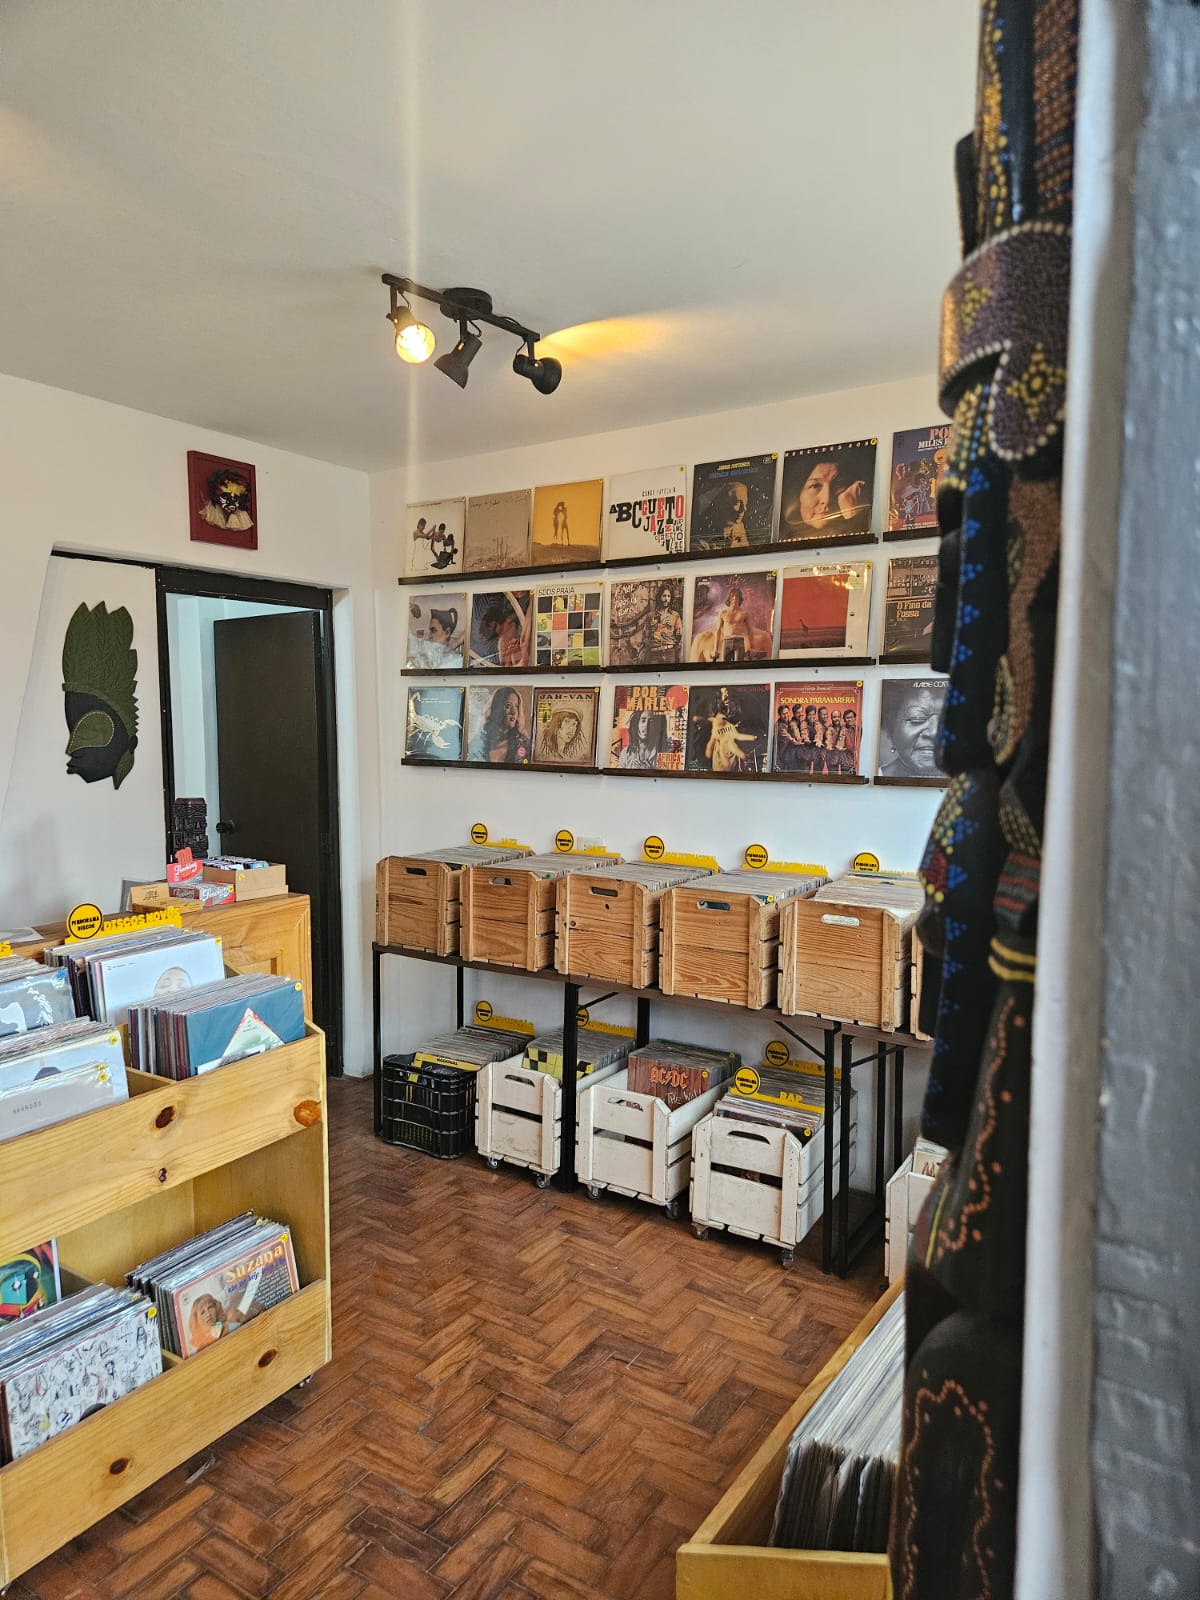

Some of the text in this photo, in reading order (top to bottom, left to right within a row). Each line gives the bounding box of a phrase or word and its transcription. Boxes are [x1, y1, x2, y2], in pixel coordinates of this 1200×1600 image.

[632, 686, 658, 698] BOB
[626, 696, 675, 710] MARLEY
[657, 753, 681, 761] AFRICA
[657, 760, 680, 769] UNITE
[174, 862, 198, 875] Smoking
[103, 905, 181, 930] DISCOS NOVOS
[650, 1066, 689, 1090] AC/DC
[665, 1092, 682, 1105] THE
[226, 1244, 284, 1285] Suzana
